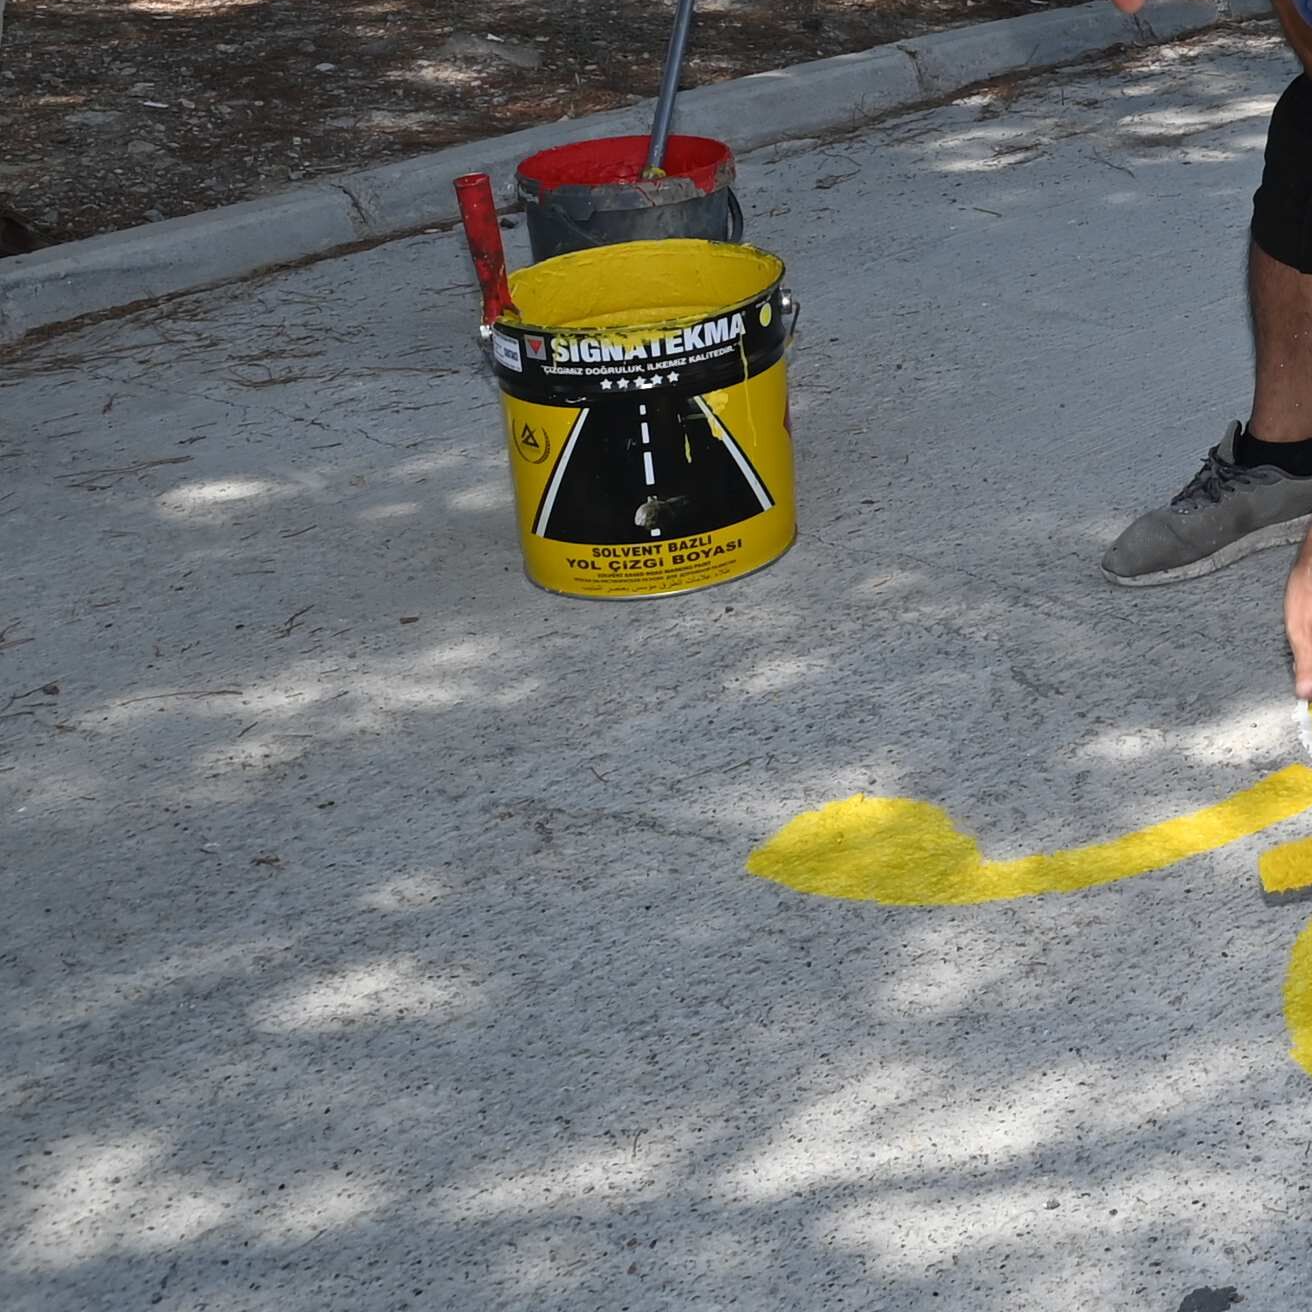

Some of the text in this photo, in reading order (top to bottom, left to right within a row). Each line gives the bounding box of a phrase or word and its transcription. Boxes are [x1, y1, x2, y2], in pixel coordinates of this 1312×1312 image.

[550, 312, 746, 363] SIGNATEKMA
[566, 557, 602, 570] YOL
[672, 538, 742, 565] BOYASI
[592, 544, 662, 558] SOLVENT
